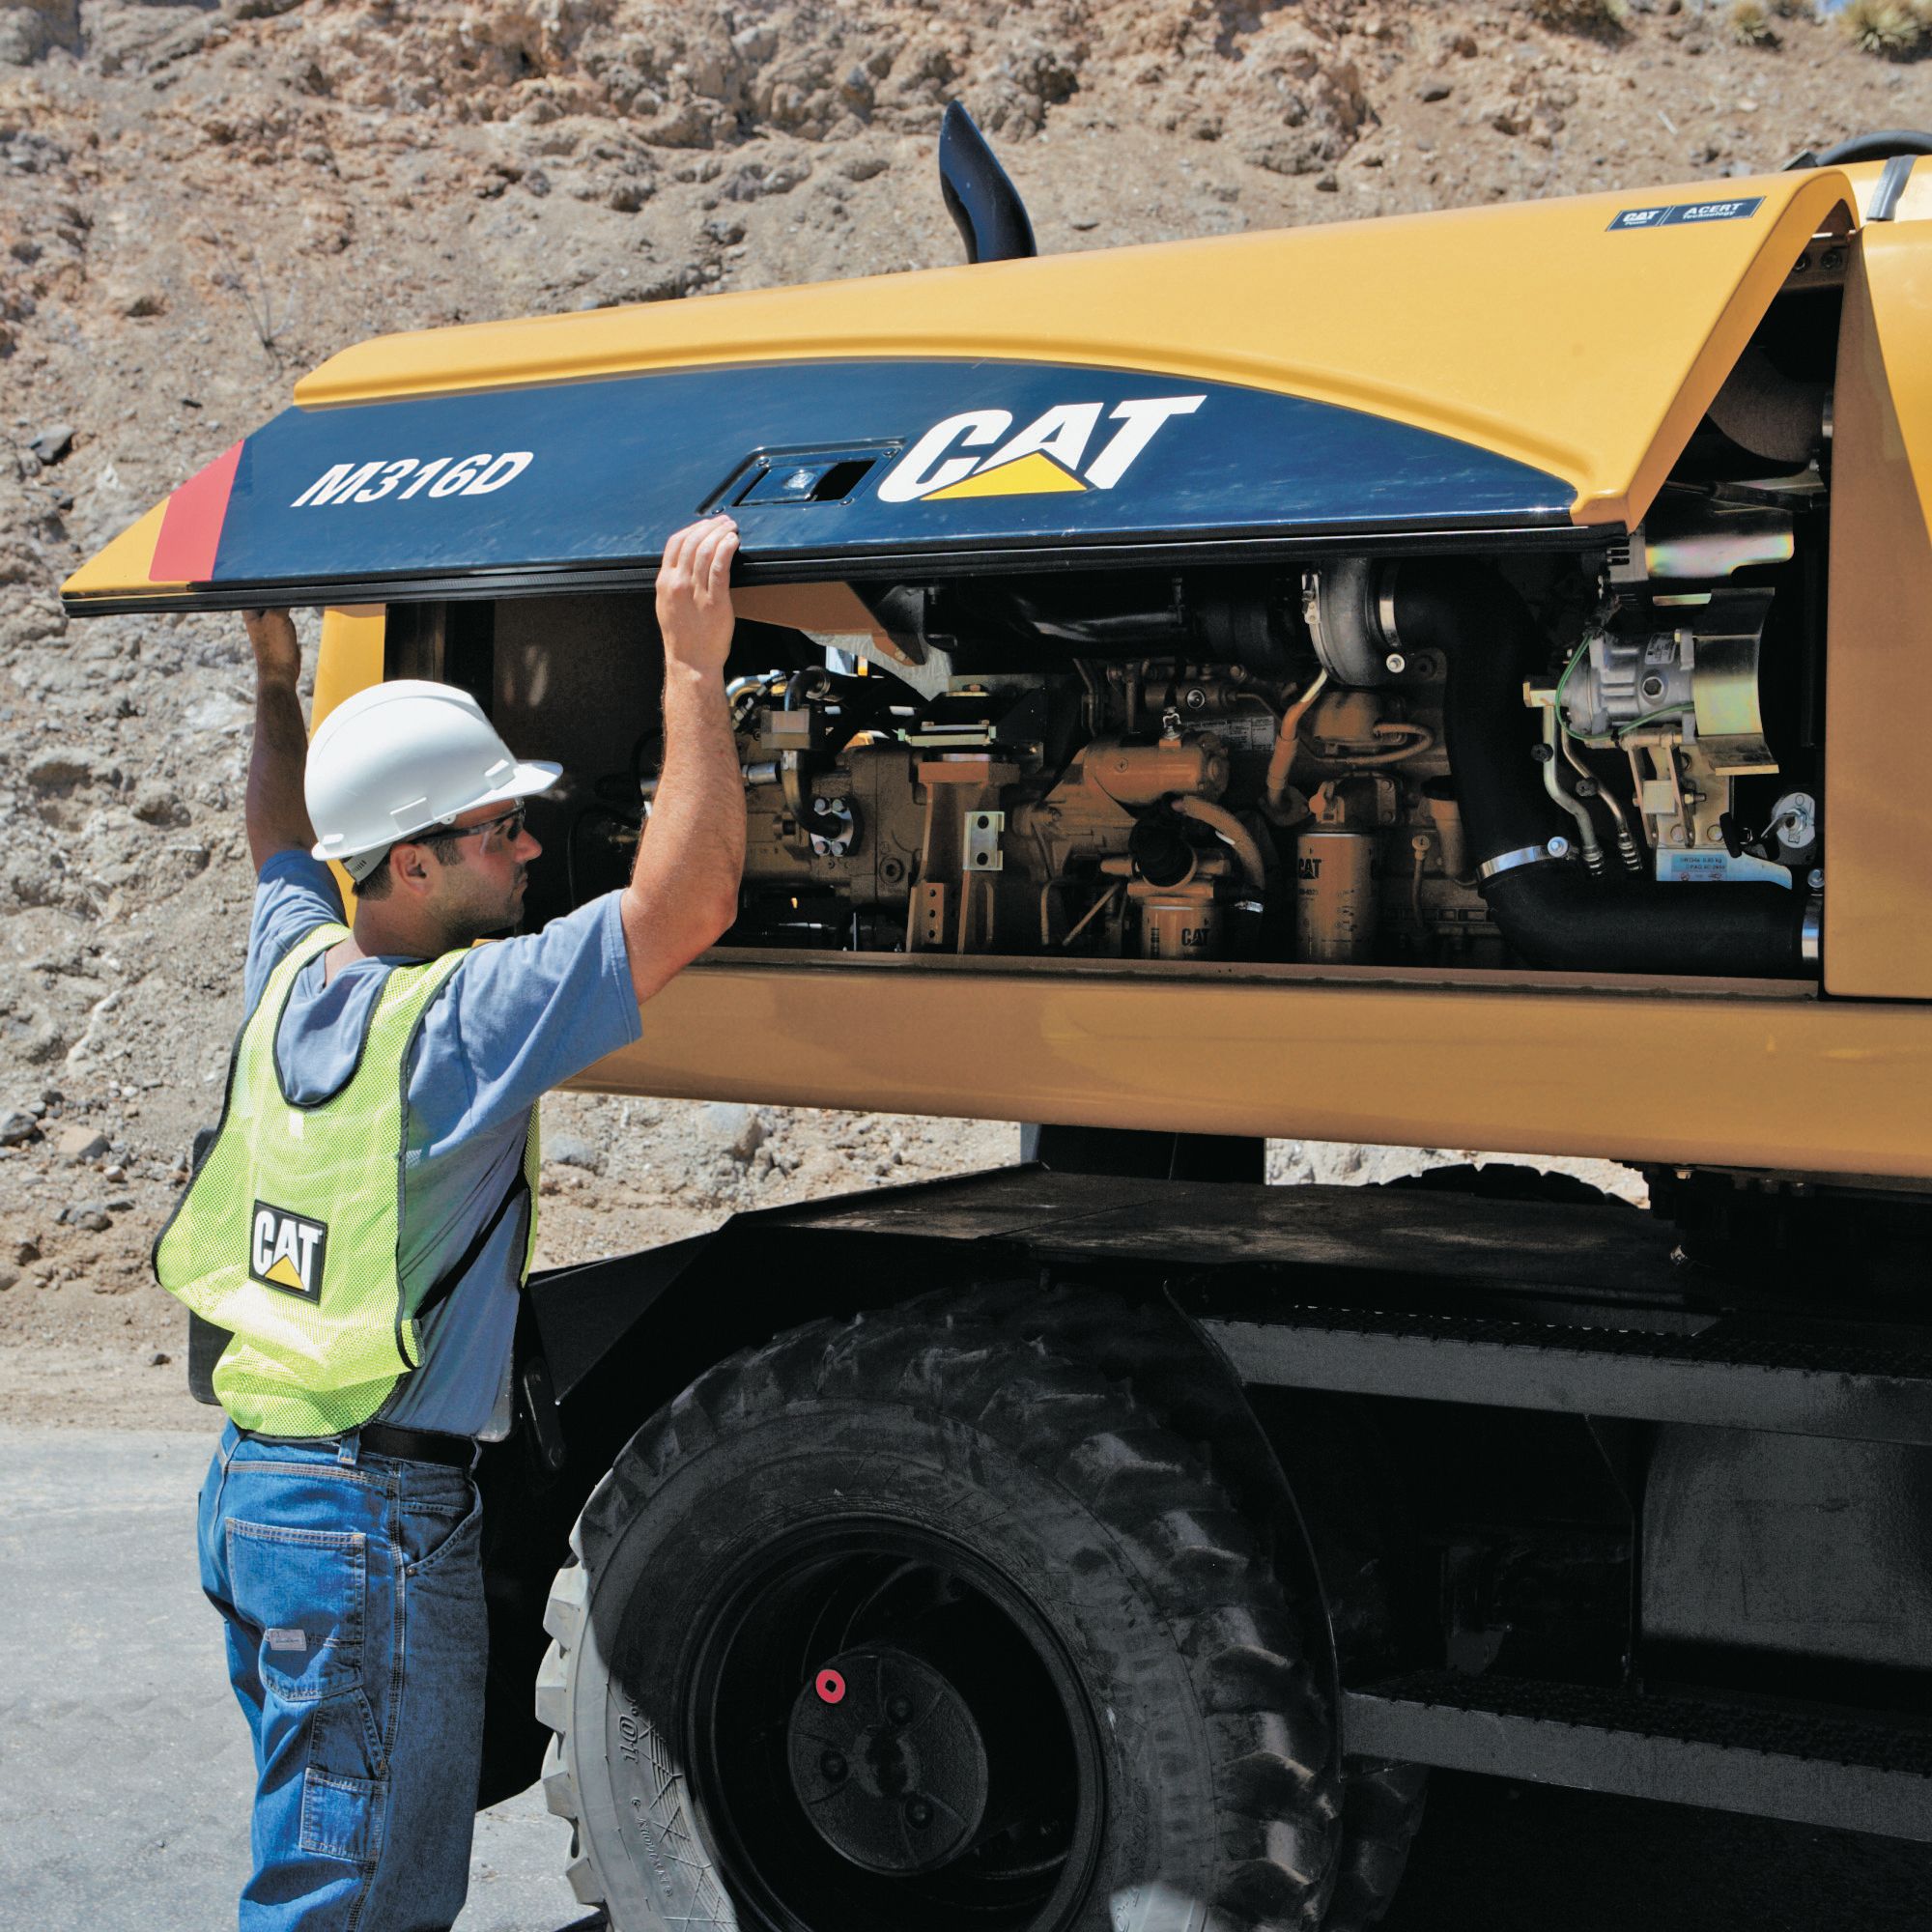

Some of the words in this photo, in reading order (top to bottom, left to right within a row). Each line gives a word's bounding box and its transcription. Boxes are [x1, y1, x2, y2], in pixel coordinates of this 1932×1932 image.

[1622, 211, 1660, 222] CAT
[1682, 211, 1736, 220] Technology
[1684, 202, 1745, 214] ACERT
[877, 394, 1208, 502] CAT
[290, 451, 534, 507] M316D
[1181, 928, 1210, 947] CAT
[252, 1209, 323, 1293] CAT
